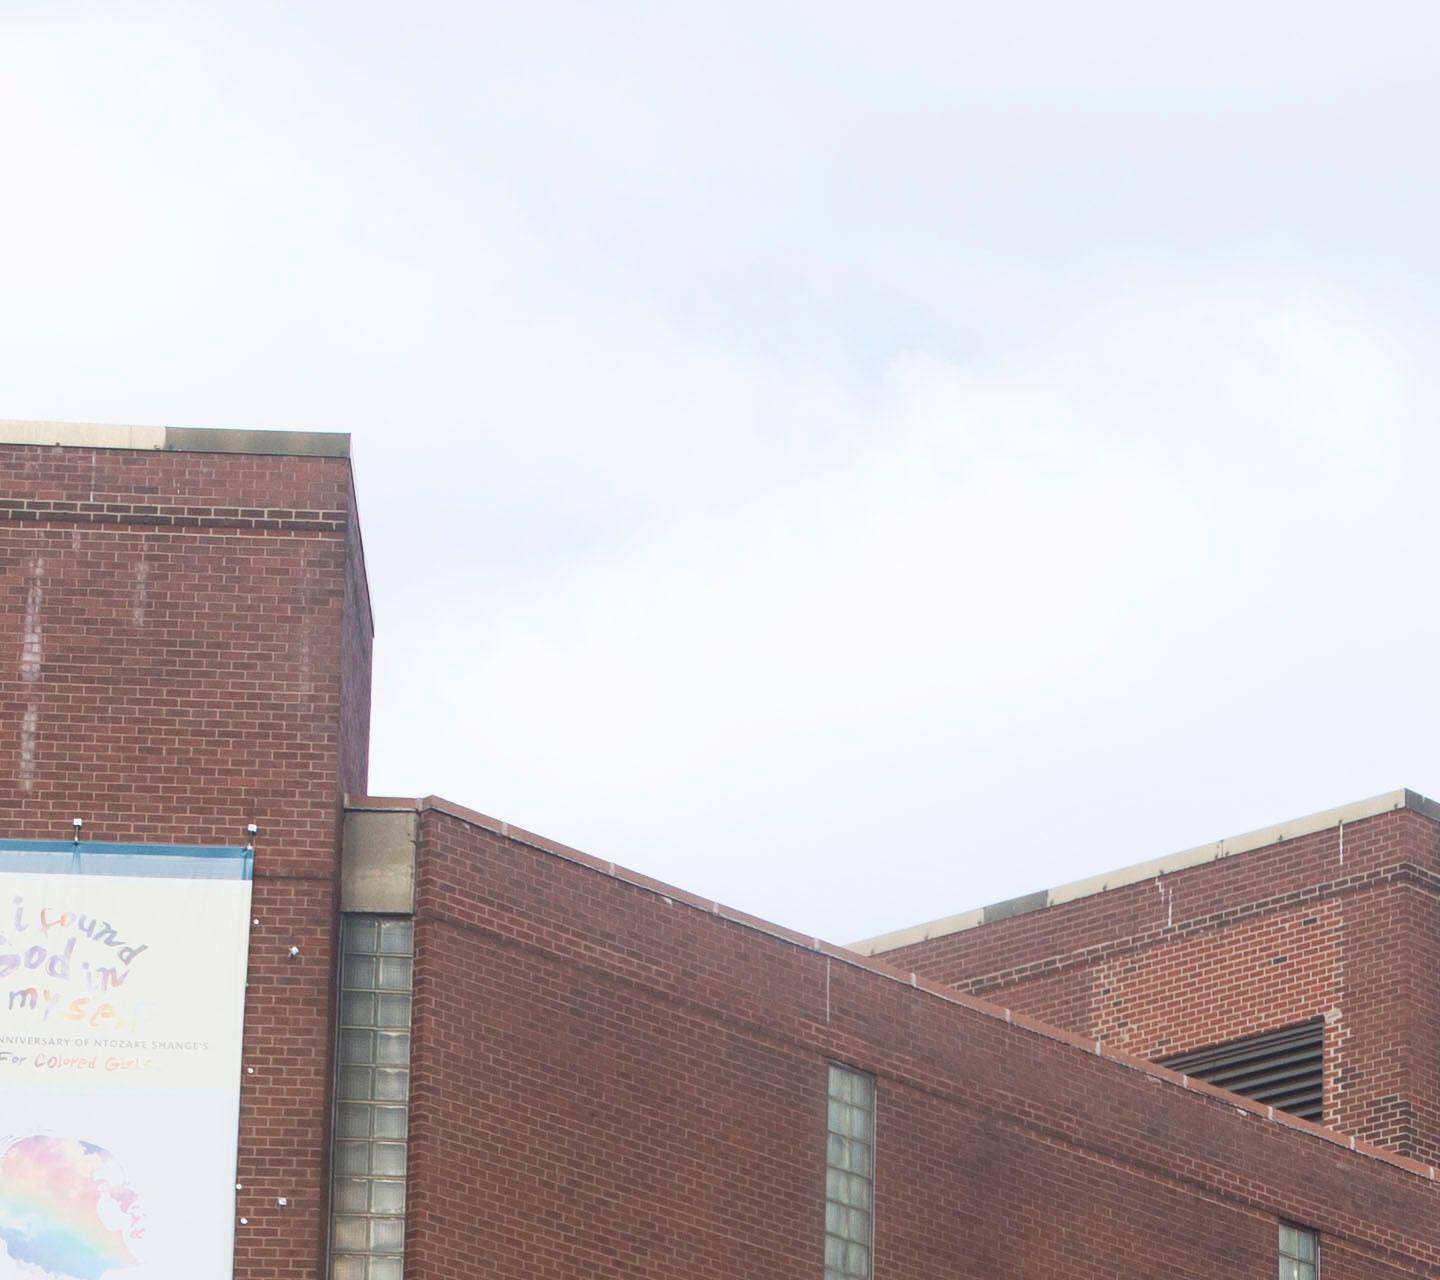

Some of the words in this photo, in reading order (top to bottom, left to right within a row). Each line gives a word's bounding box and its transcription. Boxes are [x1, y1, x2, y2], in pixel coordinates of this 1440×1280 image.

[13, 896, 30, 931] i
[40, 907, 148, 966] found
[82, 962, 130, 992] in
[74, 1038, 89, 1048] OF
[94, 1039, 147, 1049] NTOZAKE
[151, 1040, 208, 1051] SHANGE'S
[35, 1053, 97, 1070] Colored
